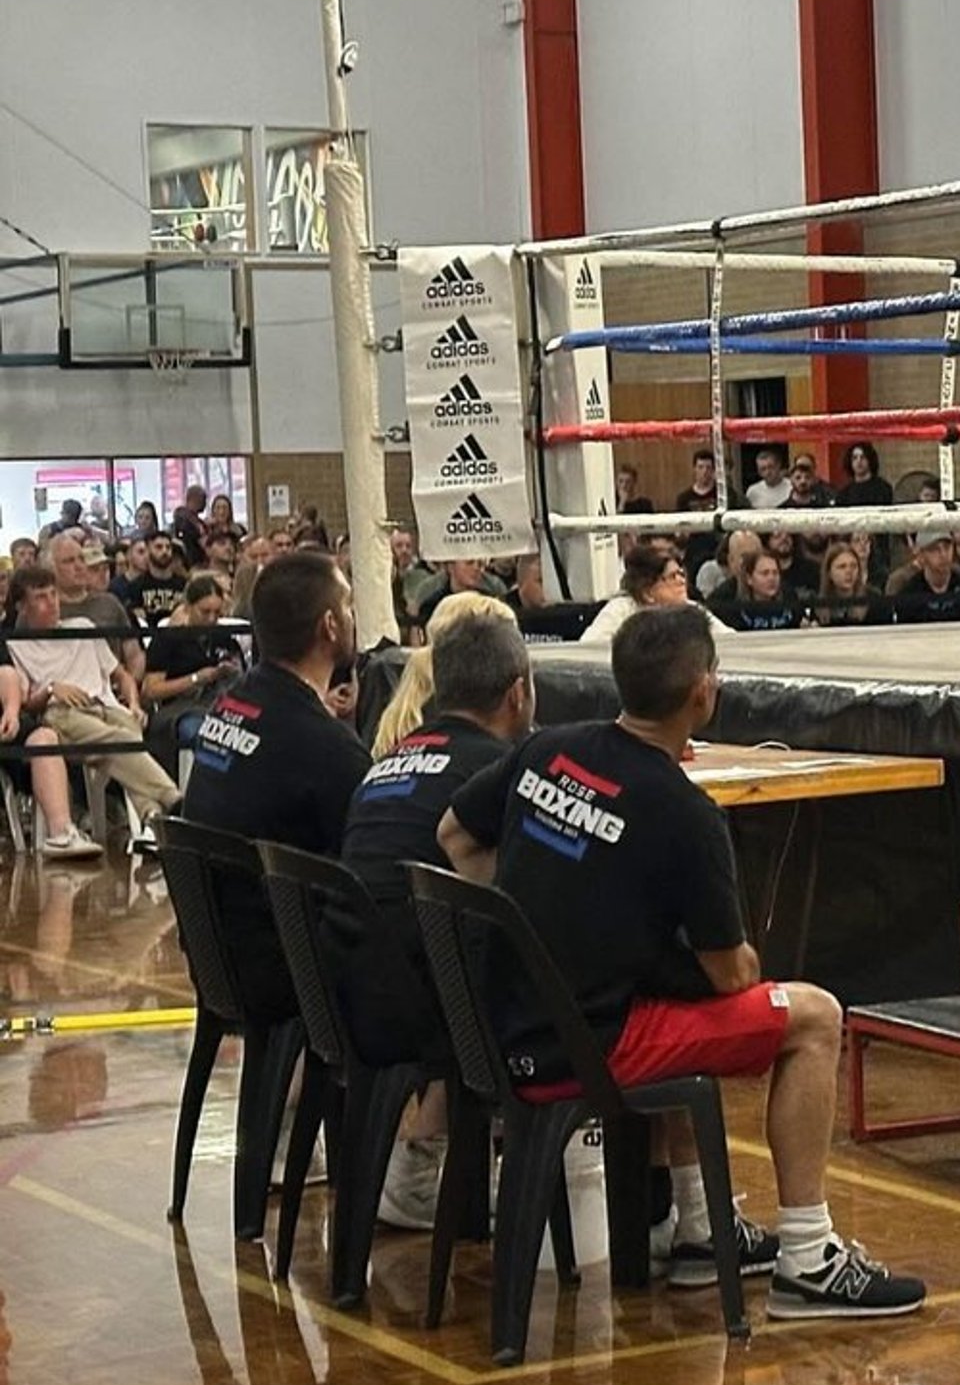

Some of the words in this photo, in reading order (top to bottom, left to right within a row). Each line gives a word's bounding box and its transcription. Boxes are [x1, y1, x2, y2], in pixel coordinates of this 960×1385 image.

[426, 281, 485, 298] adidas
[421, 300, 456, 310] COMBAT
[460, 297, 492, 307] SPORTS
[430, 341, 489, 359] adidas
[426, 360, 461, 370] COMBAT
[464, 357, 496, 367] SPORTS
[434, 400, 493, 417] adidas
[430, 419, 464, 428] COMBAT
[467, 417, 500, 426] SPORTS
[440, 460, 498, 477] adidas
[434, 479, 468, 488] COMBAT
[471, 476, 503, 485] SPORTS
[446, 519, 503, 534] adidas
[443, 536, 476, 544] COMBAT
[480, 534, 512, 543] SPORTS
[558, 774, 597, 801] ROSE
[517, 768, 625, 844] BOXING
